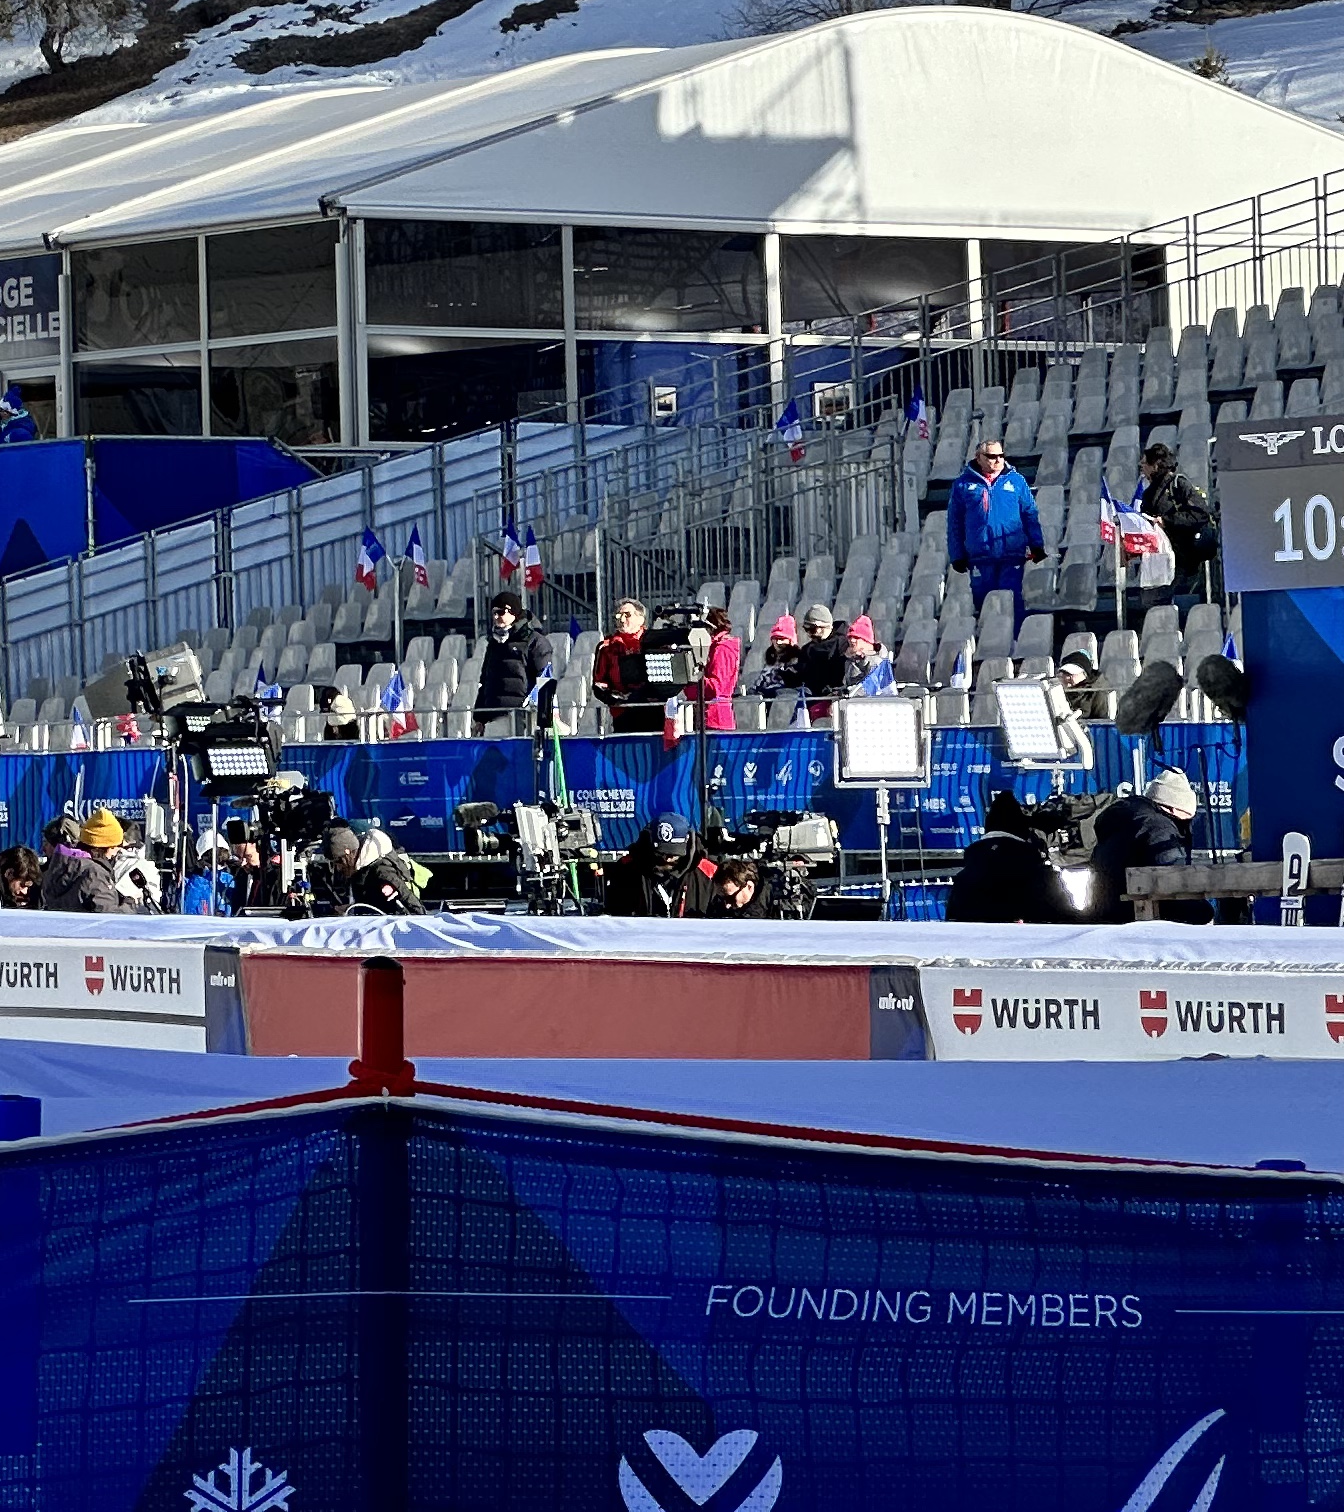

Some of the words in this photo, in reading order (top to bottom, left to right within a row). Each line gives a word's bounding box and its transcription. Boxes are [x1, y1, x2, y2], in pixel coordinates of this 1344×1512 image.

[109, 965, 181, 995] WÜRTH
[991, 999, 1101, 1031] WÜRTH
[1175, 1001, 1285, 1035] WÜRTH
[705, 1284, 933, 1324] FOUNDING
[946, 1291, 1143, 1328] MEMBERS
